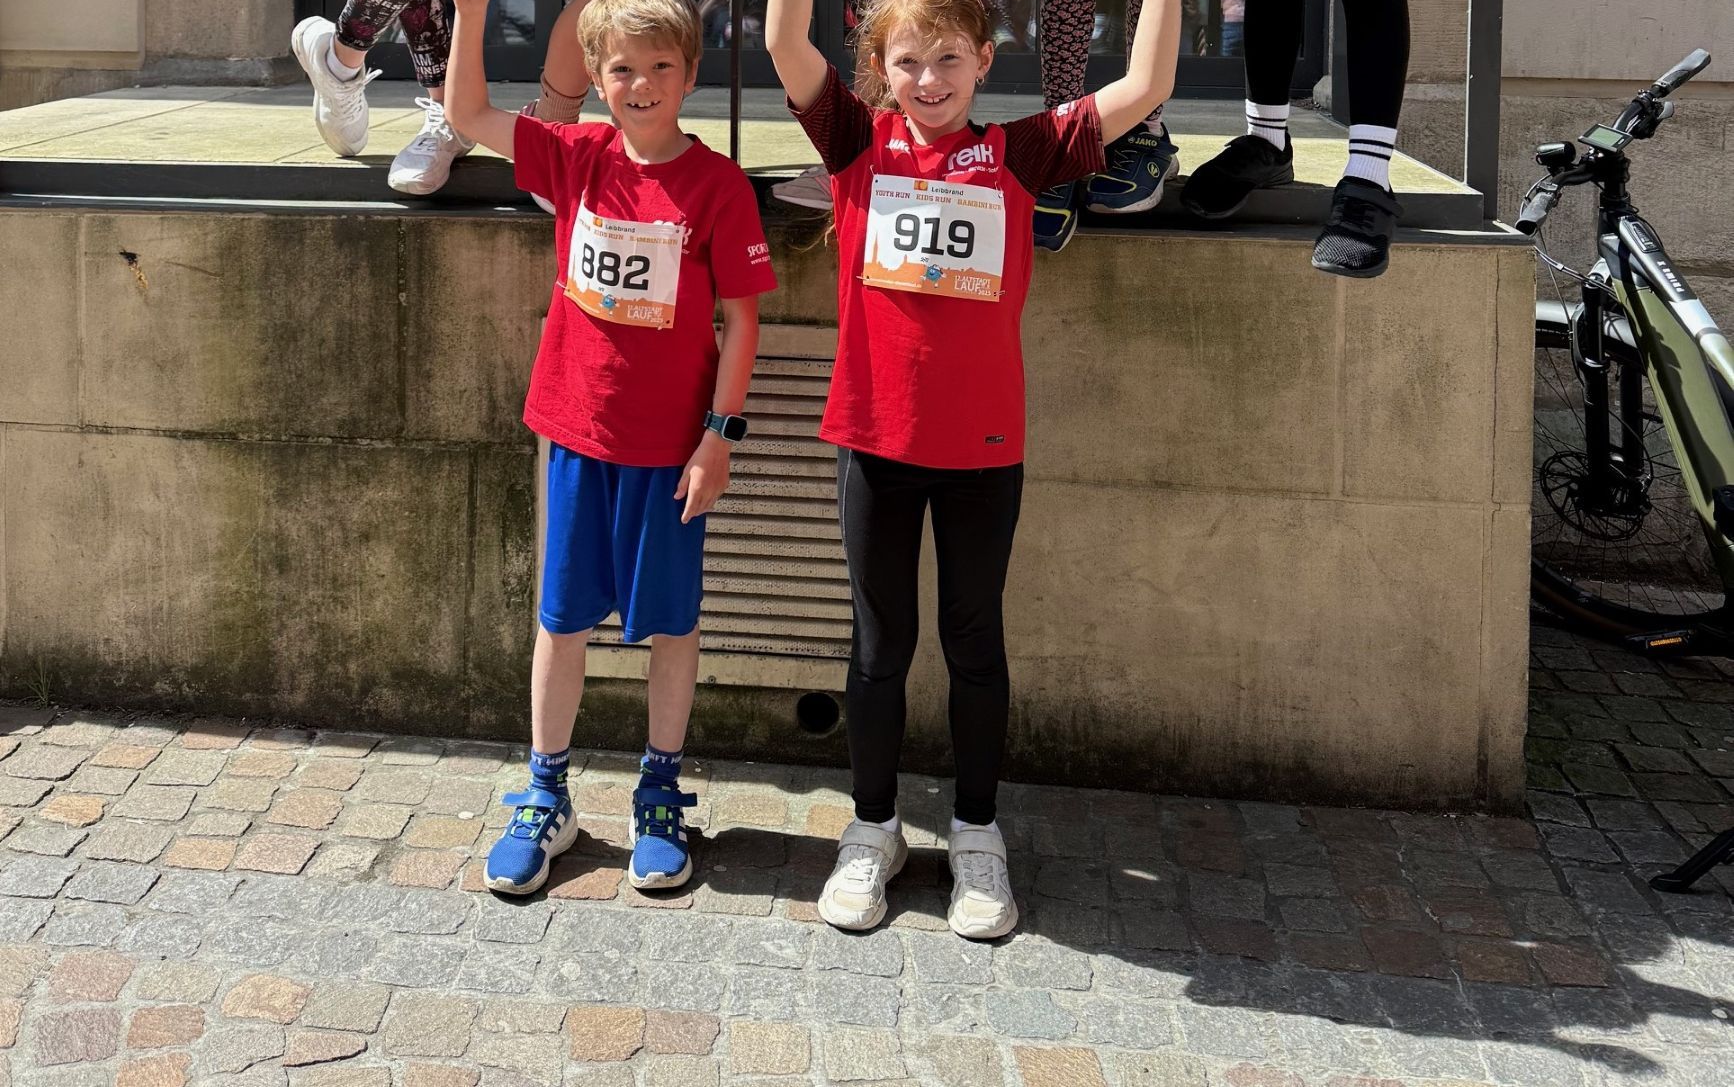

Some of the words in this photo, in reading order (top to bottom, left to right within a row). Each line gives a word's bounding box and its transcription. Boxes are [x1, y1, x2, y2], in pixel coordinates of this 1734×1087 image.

[1135, 138, 1157, 147] JAKO
[931, 186, 964, 196] Leibbrand
[875, 190, 895, 198] YOUTH
[895, 191, 911, 199] RUN
[916, 193, 934, 202] KIDS
[935, 195, 952, 204] RUN
[957, 199, 988, 209] BAMBINI
[605, 224, 635, 233] Leibbrand
[894, 213, 975, 258] 919
[582, 242, 649, 291] 882
[954, 280, 980, 293] LAUF
[627, 308, 653, 320] LAUF
